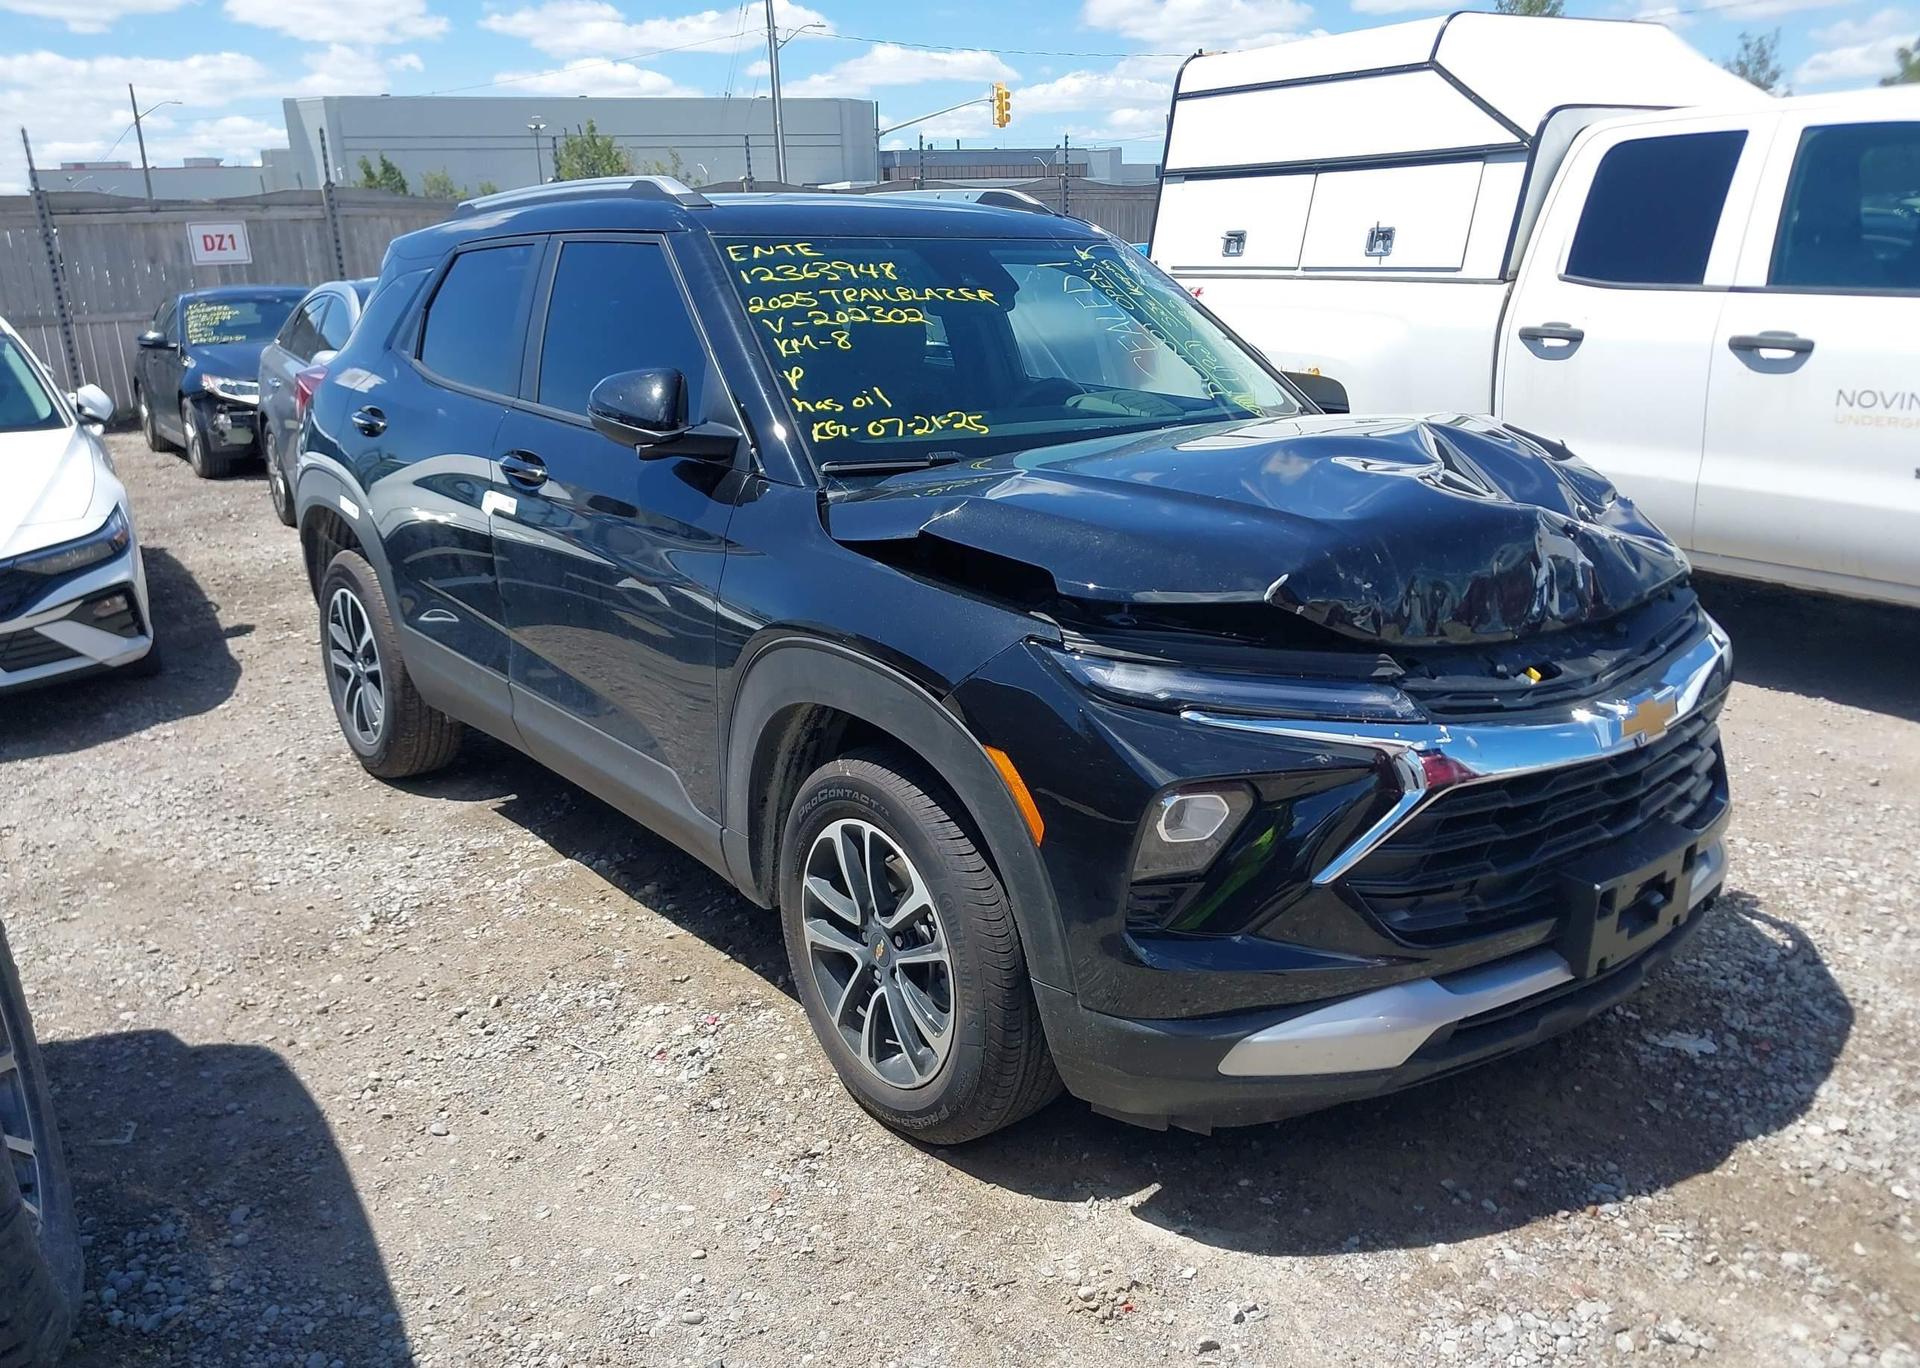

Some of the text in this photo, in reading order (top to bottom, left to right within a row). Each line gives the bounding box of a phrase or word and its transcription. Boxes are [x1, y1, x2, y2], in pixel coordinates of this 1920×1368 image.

[202, 233, 237, 252] DZ1
[726, 243, 825, 261] ENTE
[740, 260, 898, 284] 12363948
[748, 286, 1000, 313] 2025 TRAILBLAZER
[791, 386, 892, 413] has oil
